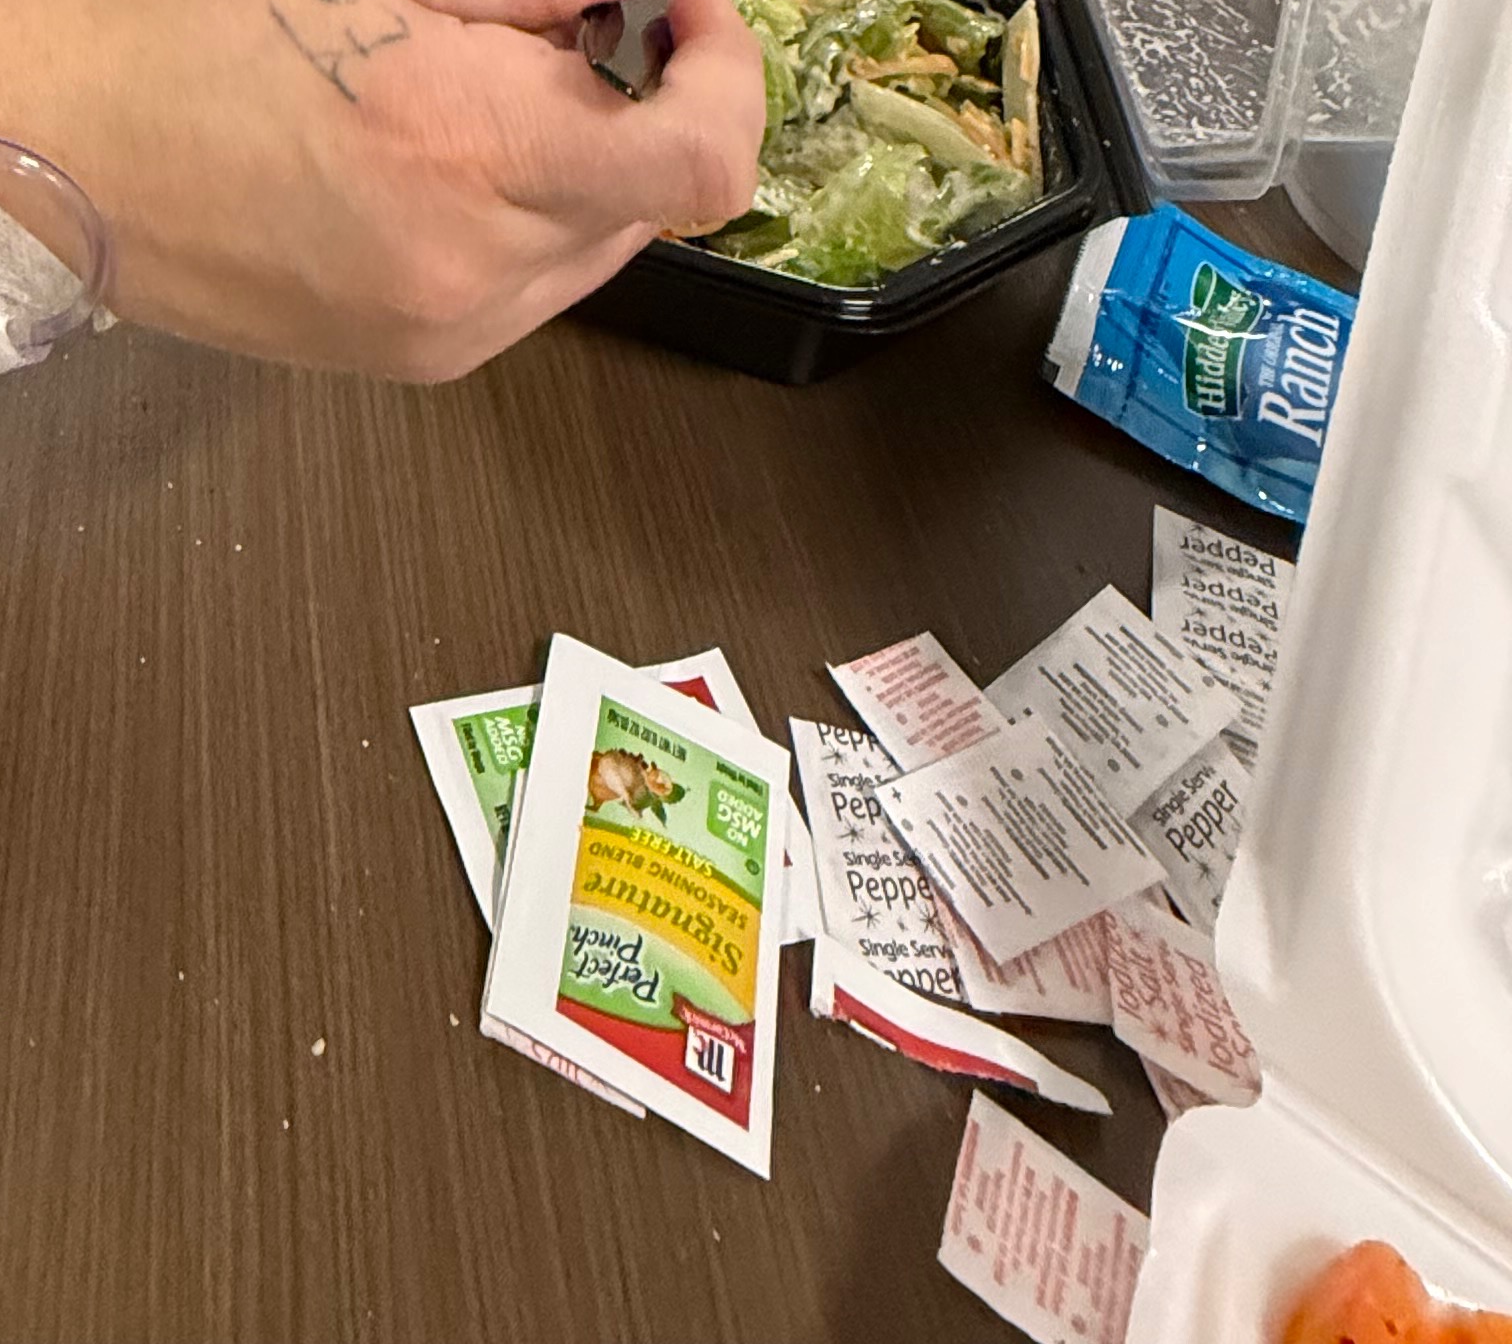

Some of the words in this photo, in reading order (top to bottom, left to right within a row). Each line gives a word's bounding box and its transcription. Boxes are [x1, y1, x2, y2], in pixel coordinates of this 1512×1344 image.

[1257, 307, 1341, 449] Ranch
[1180, 536, 1277, 577] Pepper
[1181, 574, 1279, 620] Pepper
[494, 715, 524, 761] MSG
[827, 773, 876, 792] Single
[716, 790, 763, 821] ADDED
[716, 804, 763, 839] MSG
[831, 791, 882, 826] Pep
[1165, 779, 1240, 863] Pepper
[589, 841, 646, 870] BLEND
[629, 827, 673, 856] FREE
[726, 827, 749, 848] NO
[674, 849, 719, 878] SALT
[843, 850, 892, 871] Single
[647, 859, 749, 930] SEASONING
[572, 924, 643, 963] Pinch
[583, 872, 744, 976] Signature
[858, 938, 910, 963] Single
[569, 952, 660, 1003] Perfect
[1129, 947, 1168, 1011] Salt
[1174, 947, 1240, 1079] Iodized
